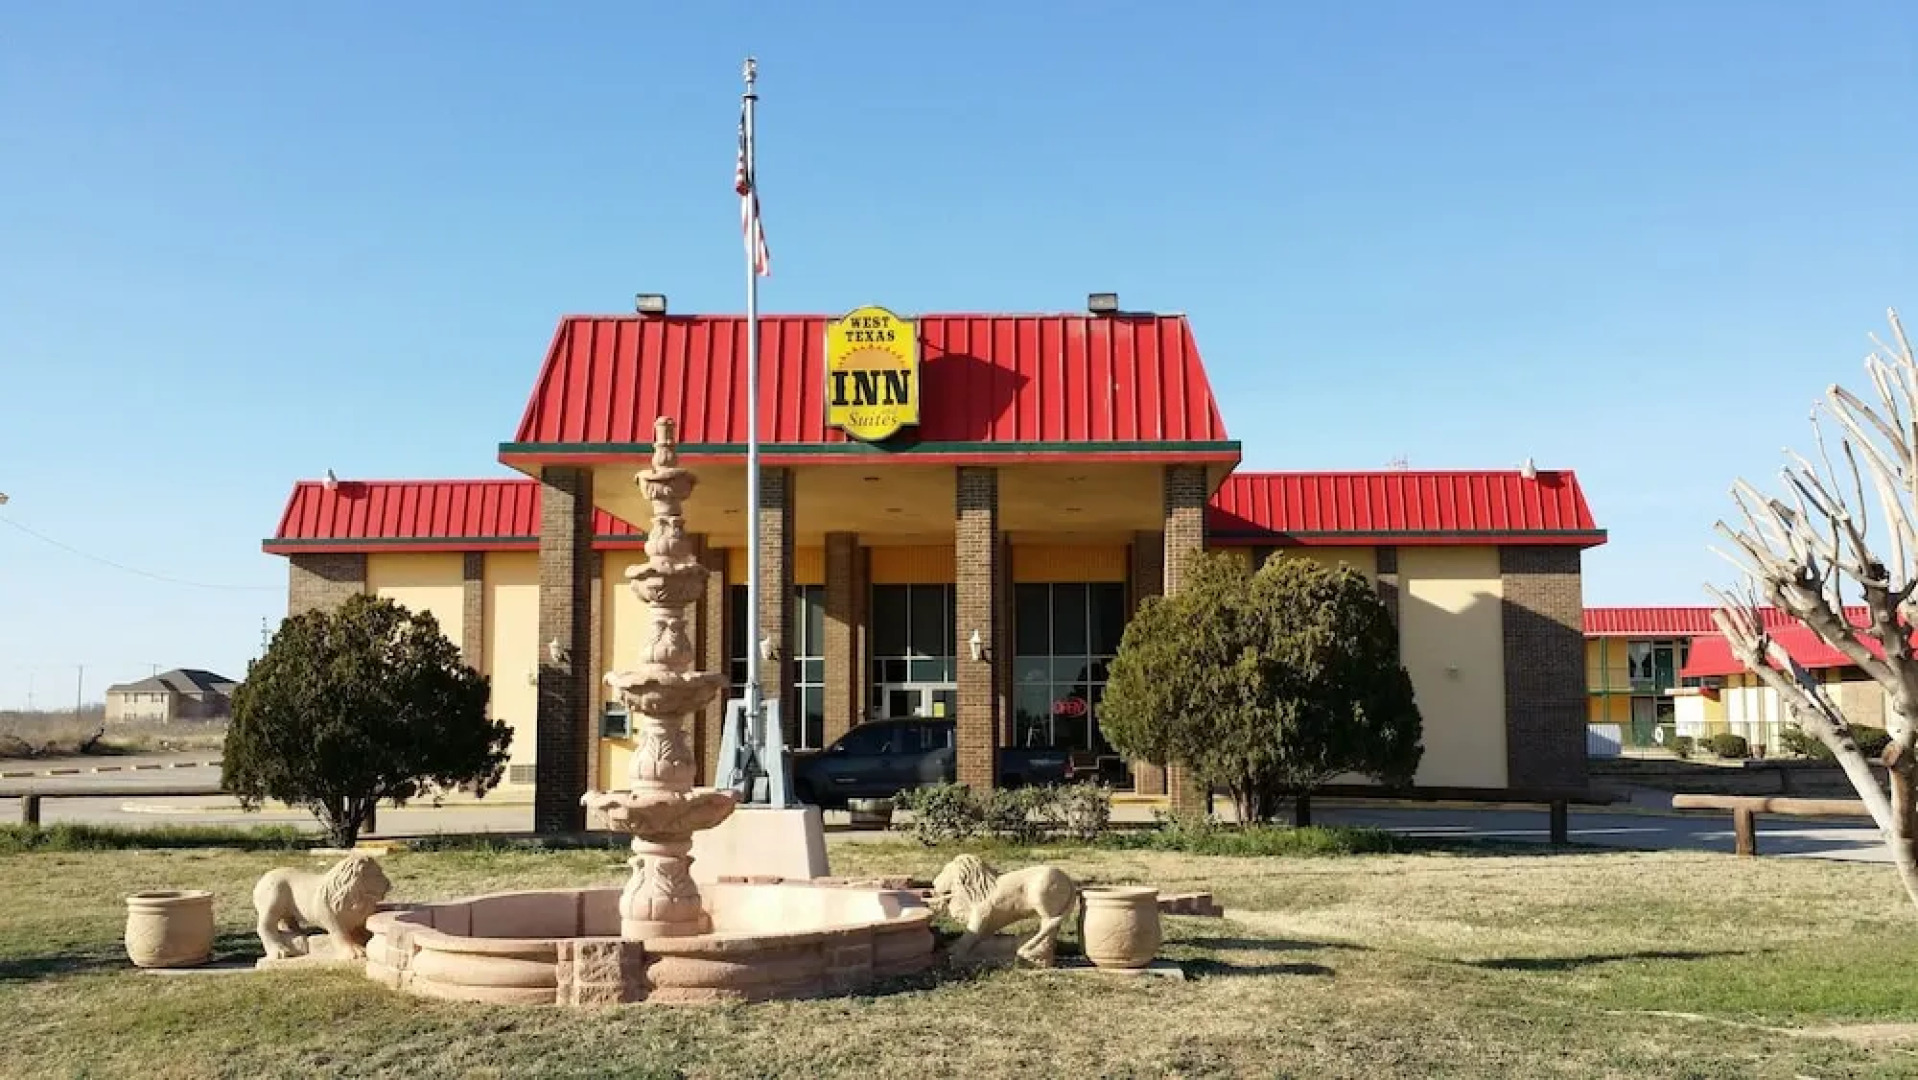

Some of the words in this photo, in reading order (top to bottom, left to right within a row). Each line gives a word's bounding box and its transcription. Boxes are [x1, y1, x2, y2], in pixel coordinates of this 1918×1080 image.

[850, 316, 890, 328] WEST
[846, 330, 895, 342] TEXAS
[832, 370, 911, 405] INN
[1053, 700, 1082, 715] OPEN
